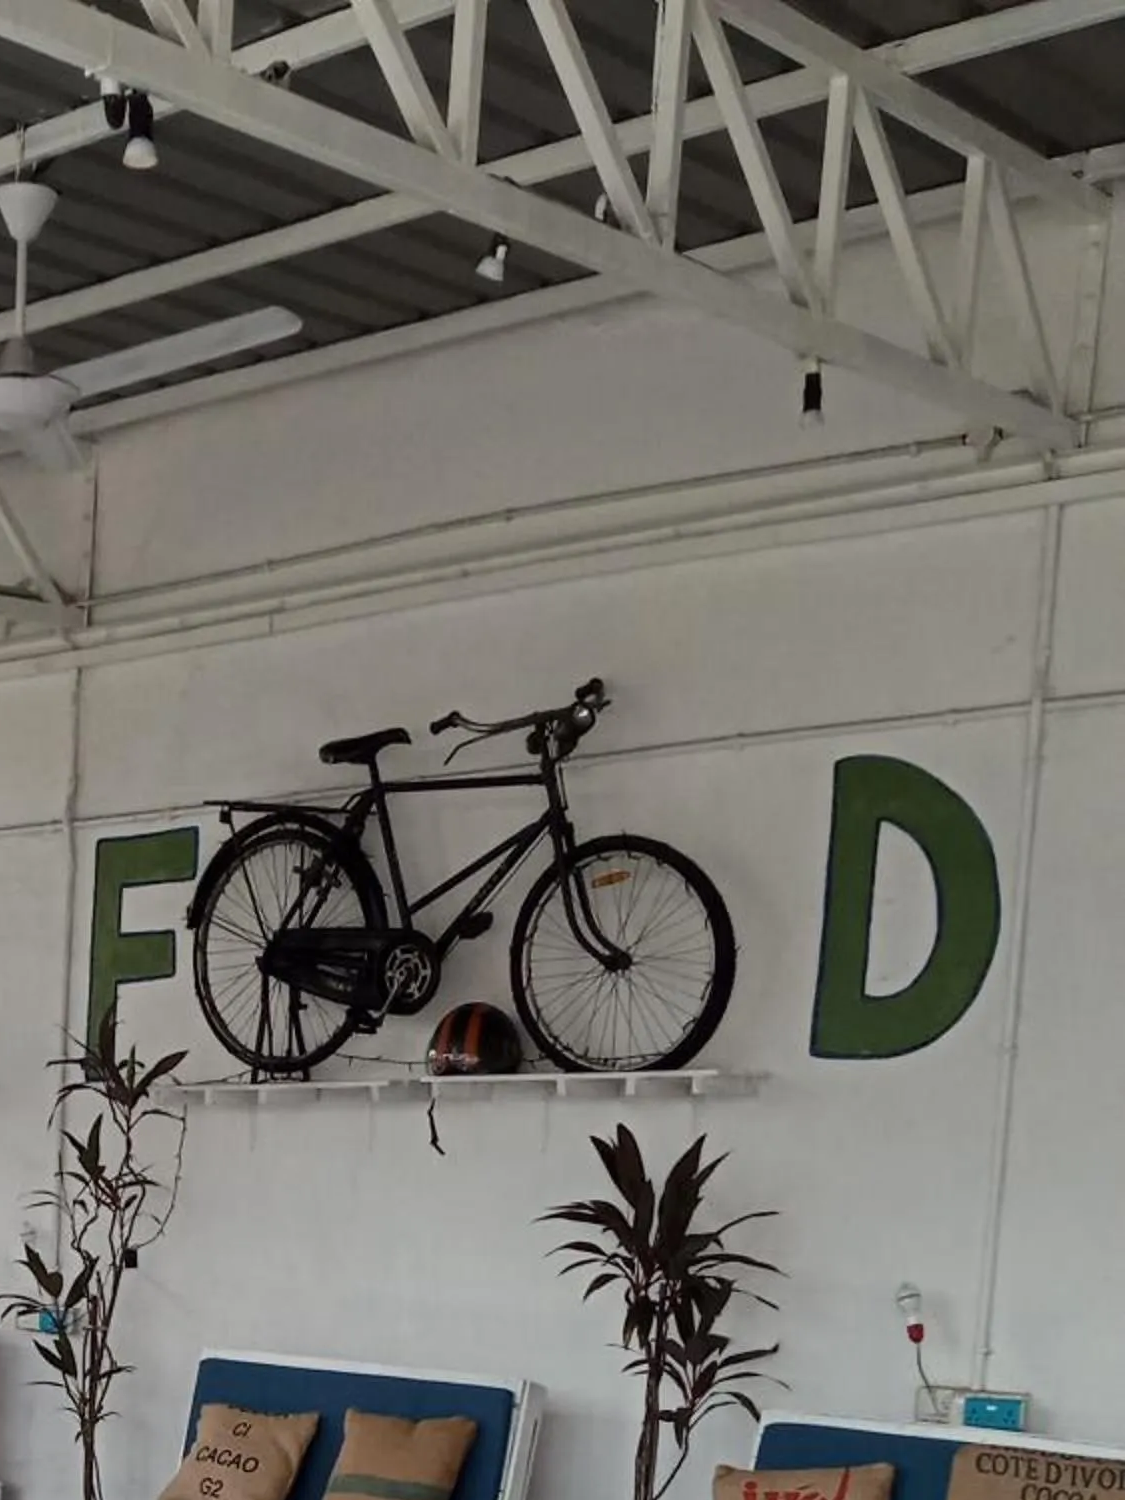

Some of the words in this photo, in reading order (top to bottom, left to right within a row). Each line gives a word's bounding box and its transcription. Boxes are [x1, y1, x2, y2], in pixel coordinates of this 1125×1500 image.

[809, 755, 1001, 1060] D
[233, 1421, 252, 1437] CI
[196, 1445, 259, 1473] CACAO
[975, 1452, 1040, 1481] COTE
[199, 1477, 224, 1498] G2
